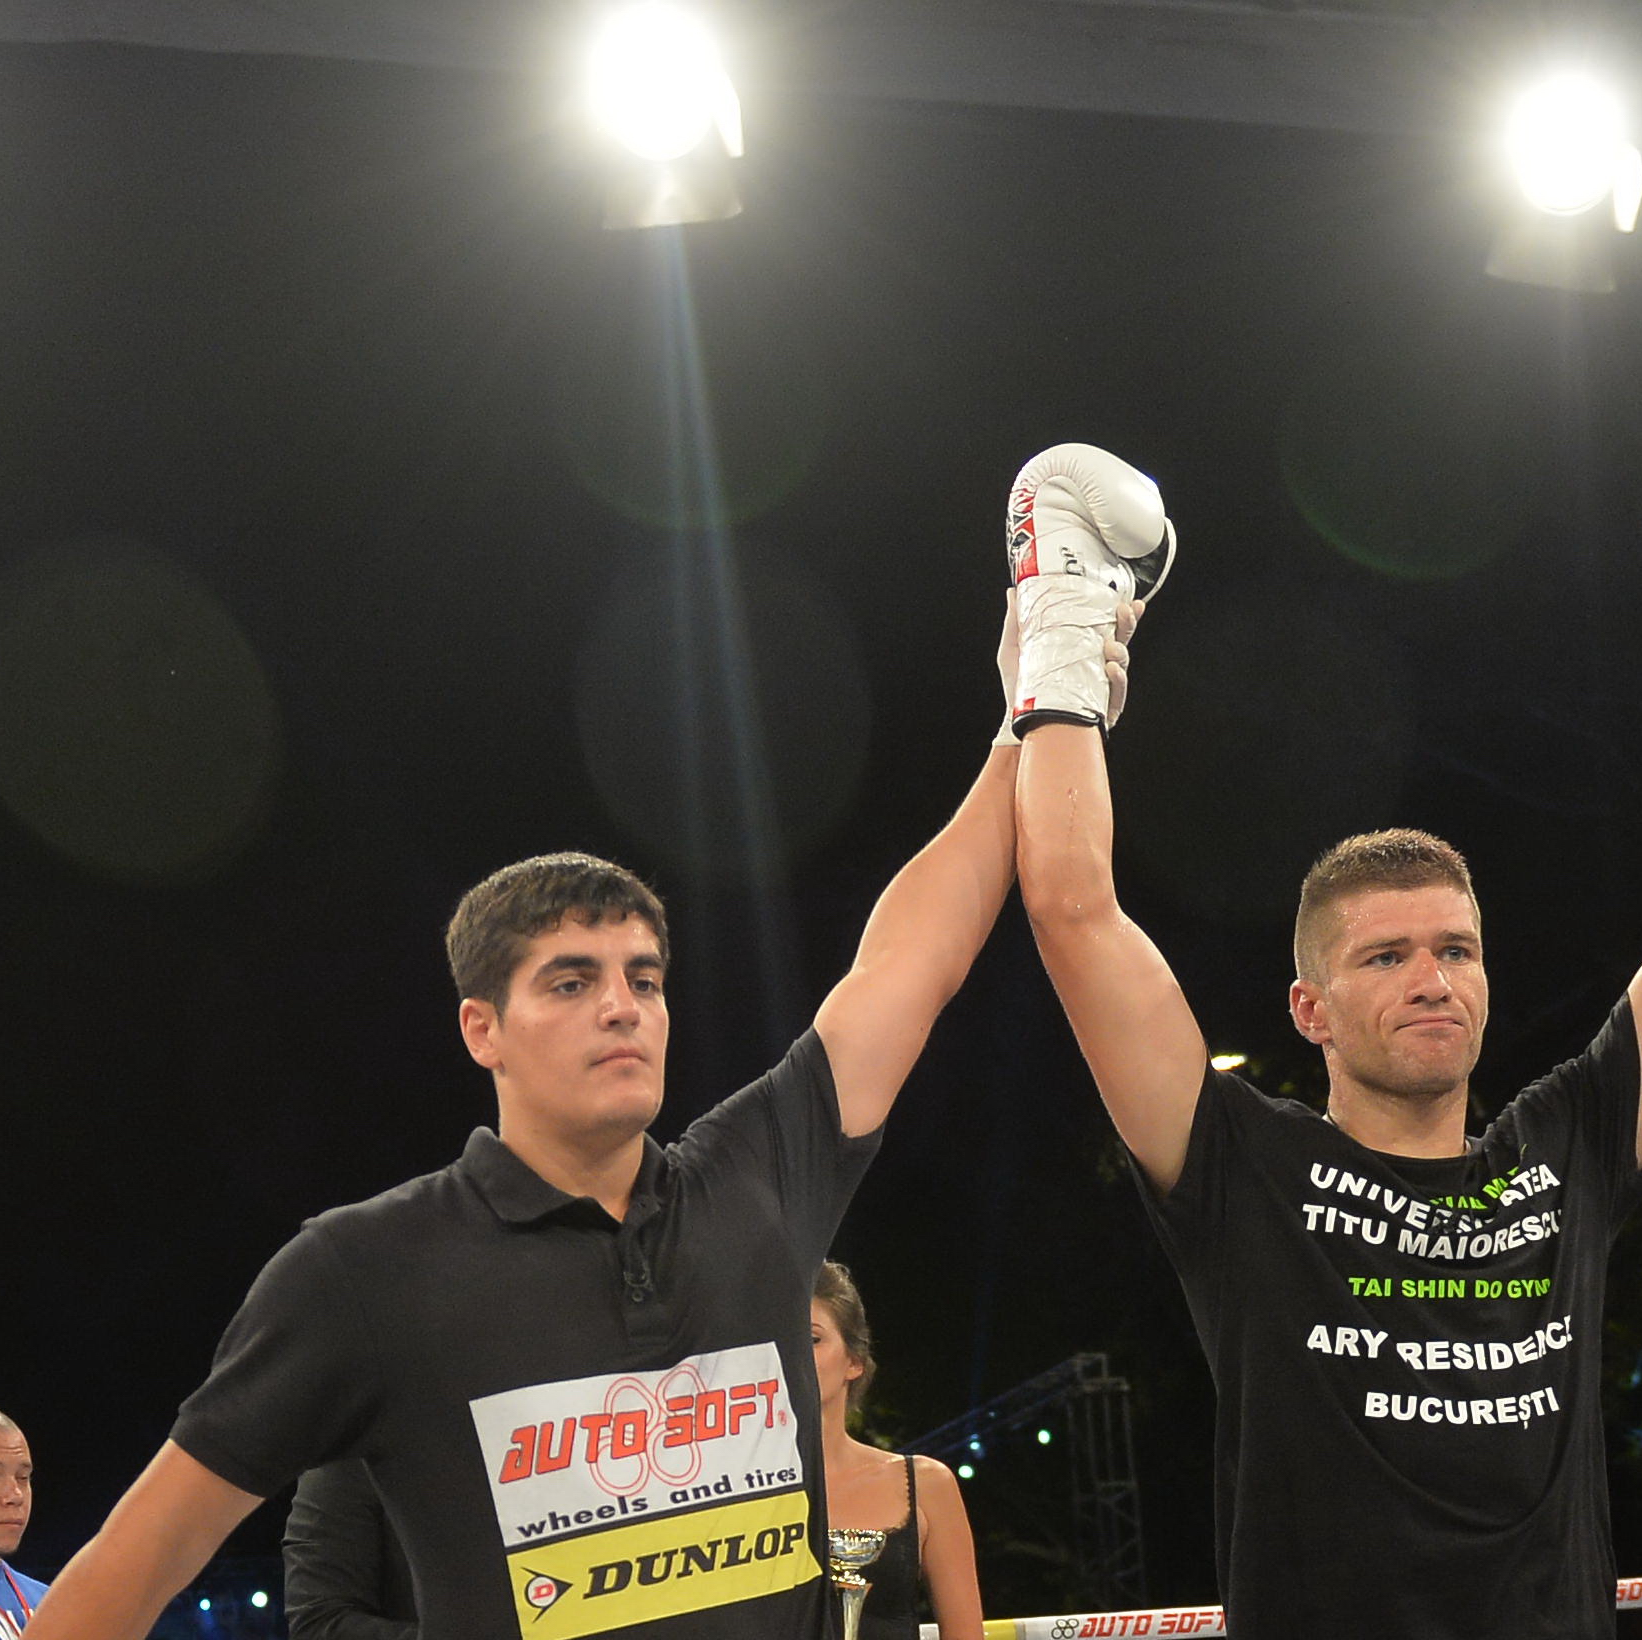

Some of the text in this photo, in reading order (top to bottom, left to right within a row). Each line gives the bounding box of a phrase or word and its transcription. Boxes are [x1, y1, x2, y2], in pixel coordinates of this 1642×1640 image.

[1302, 1203, 1388, 1245] TITU
[1348, 1277, 1392, 1297] TAI
[1401, 1279, 1466, 1298] SHIN
[1475, 1279, 1503, 1298] DO
[1307, 1324, 1389, 1359] ARY
[499, 1409, 647, 1484] AUTO
[517, 1466, 797, 1539] wheels and tires
[583, 1522, 805, 1599] DUNLOP
[1078, 1614, 1153, 1638] AUTO
